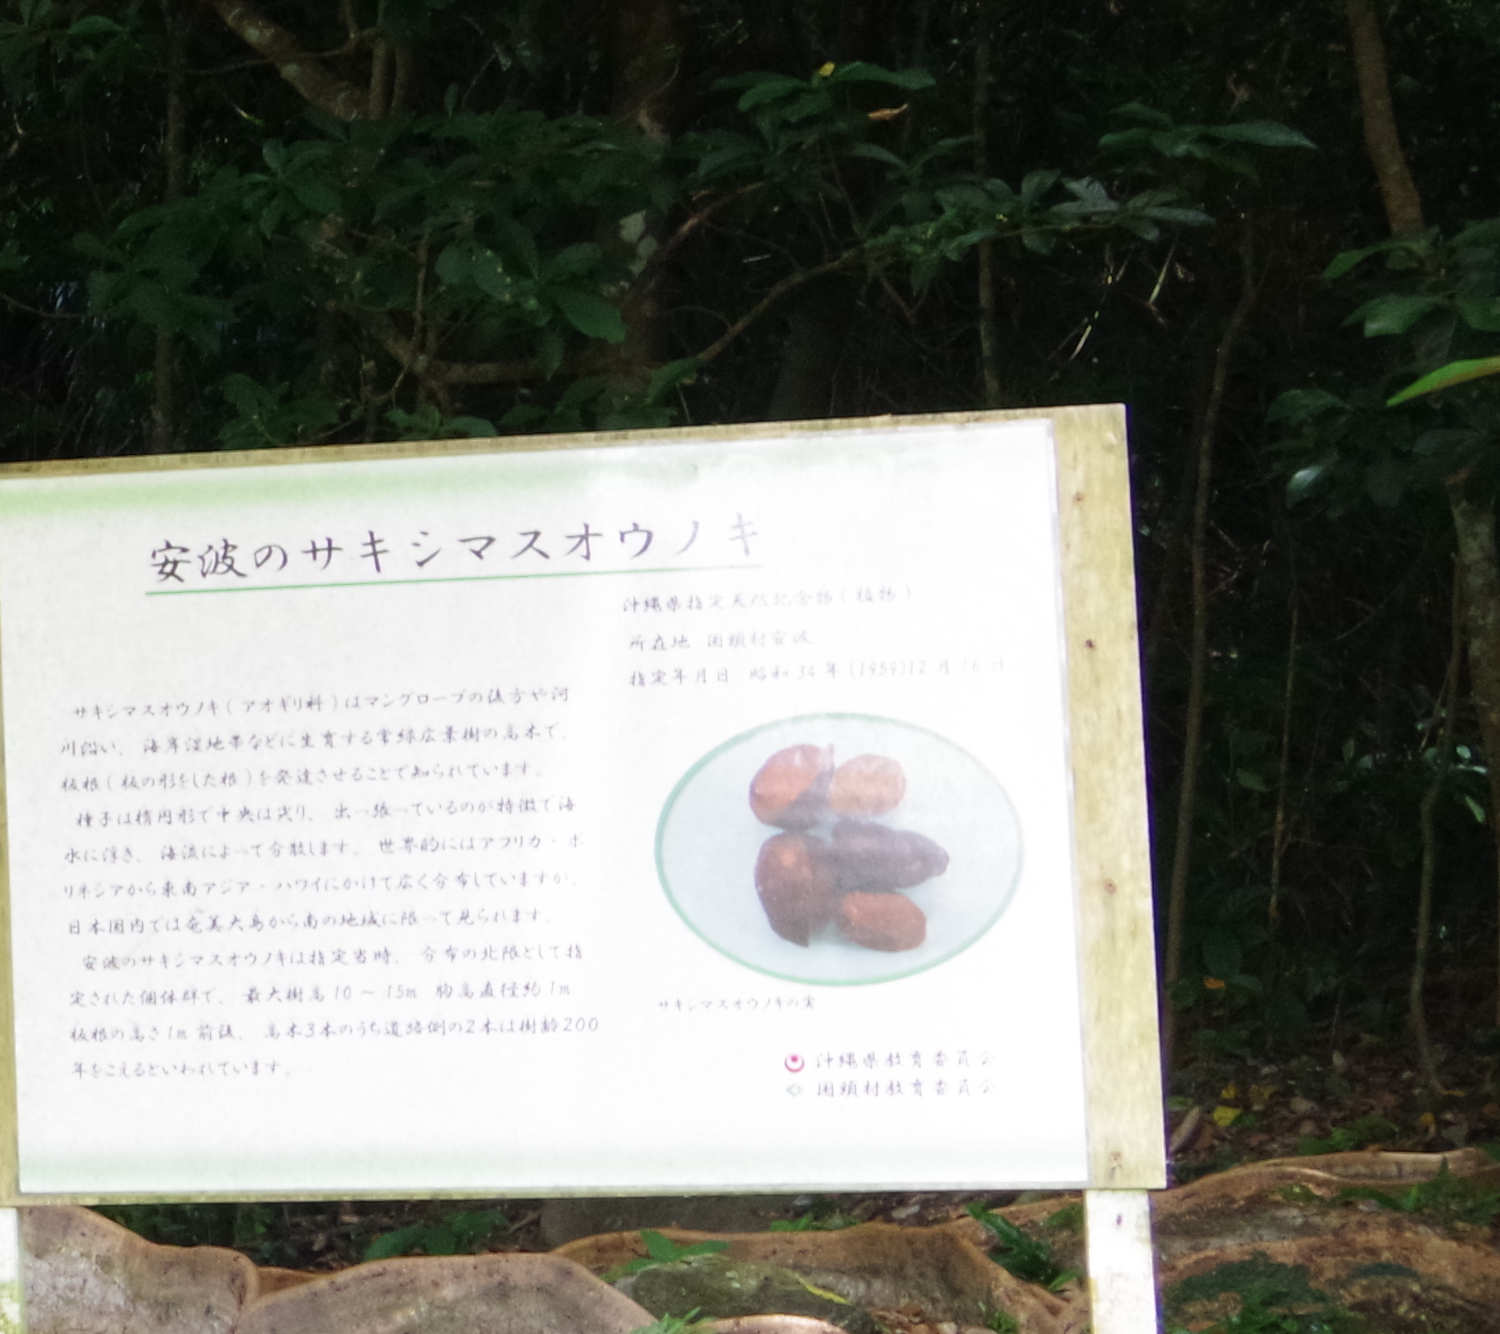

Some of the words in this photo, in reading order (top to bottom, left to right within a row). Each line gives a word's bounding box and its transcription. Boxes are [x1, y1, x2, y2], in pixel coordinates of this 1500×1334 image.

[149, 512, 758, 584] 安波のサキシマスオウノキ
[628, 632, 691, 653] 所在地
[706, 628, 812, 650] 国頭村安波
[628, 667, 729, 689] 指定年月日
[657, 994, 816, 1012] サキシマスオウノキの実
[815, 1048, 998, 1070] 沖縄県教育委員会
[816, 1077, 998, 1099] 国頭村教育委員会
